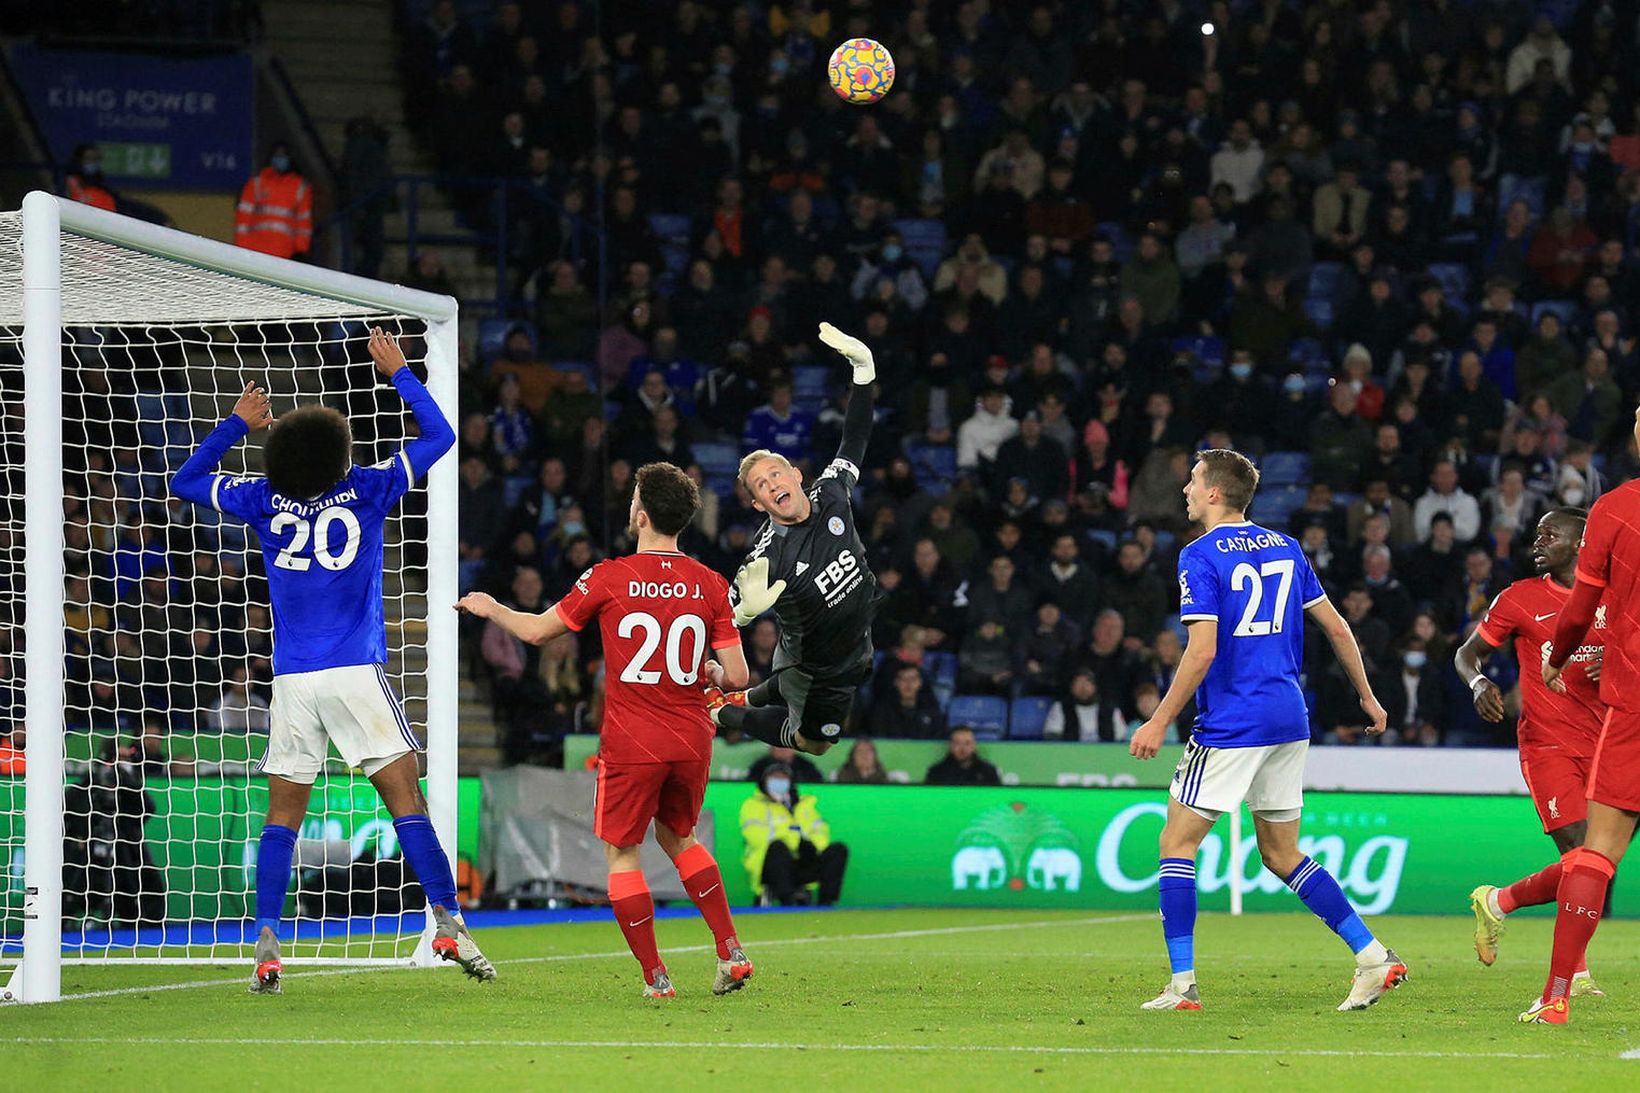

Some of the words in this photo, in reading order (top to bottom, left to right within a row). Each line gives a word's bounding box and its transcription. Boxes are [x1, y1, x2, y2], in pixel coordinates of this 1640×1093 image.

[48, 87, 117, 112] KING
[124, 89, 217, 114] POWER
[270, 505, 362, 572] 20
[1215, 533, 1289, 553] CASTAGNE
[628, 580, 687, 598] DIOGO
[691, 583, 704, 600] J.
[814, 549, 857, 595] FBS
[1230, 559, 1295, 637] 27
[617, 611, 706, 686] 20
